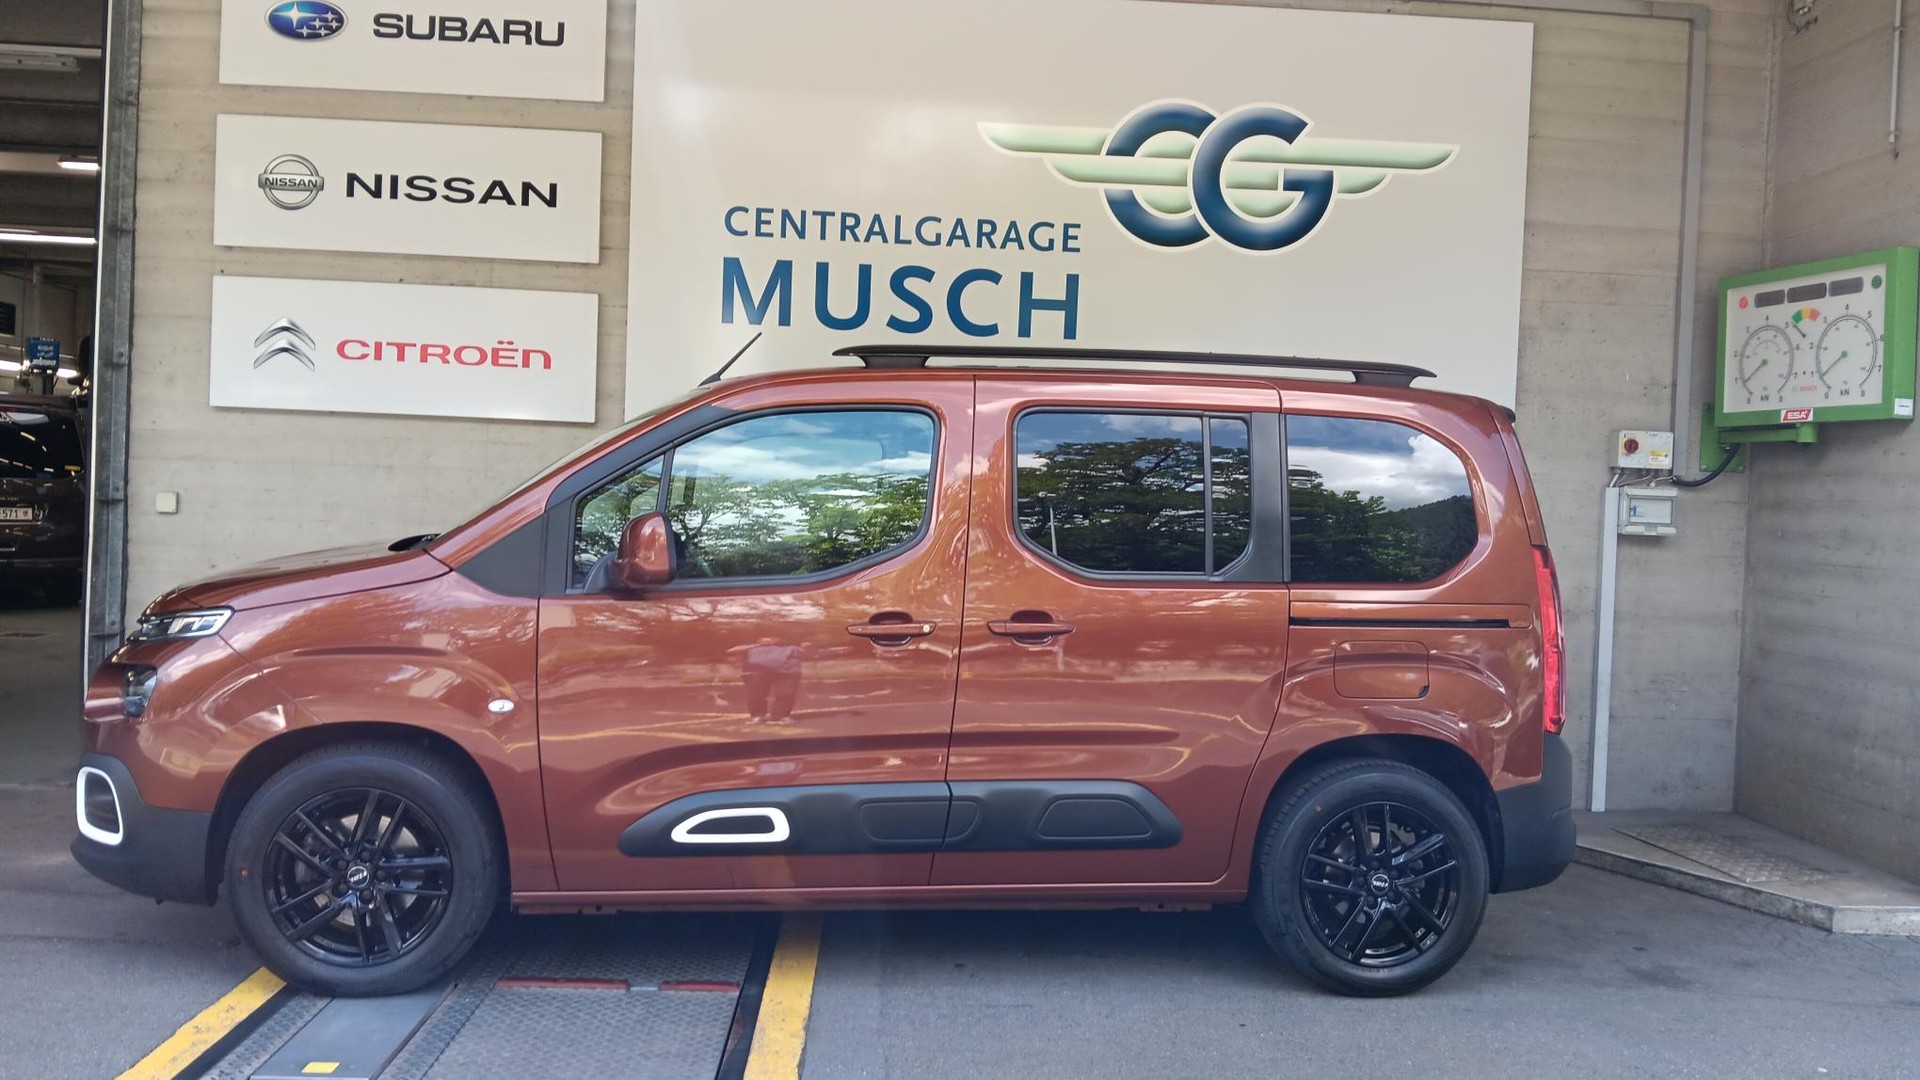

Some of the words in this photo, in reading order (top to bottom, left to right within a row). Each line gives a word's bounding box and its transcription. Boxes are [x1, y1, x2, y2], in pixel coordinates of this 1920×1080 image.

[373, 13, 565, 46] SUBARU
[264, 176, 318, 188] NISSAN
[346, 172, 558, 208] NISSAN
[724, 205, 1081, 253] CENTRALGARAGE
[721, 256, 1080, 341] MUSCH
